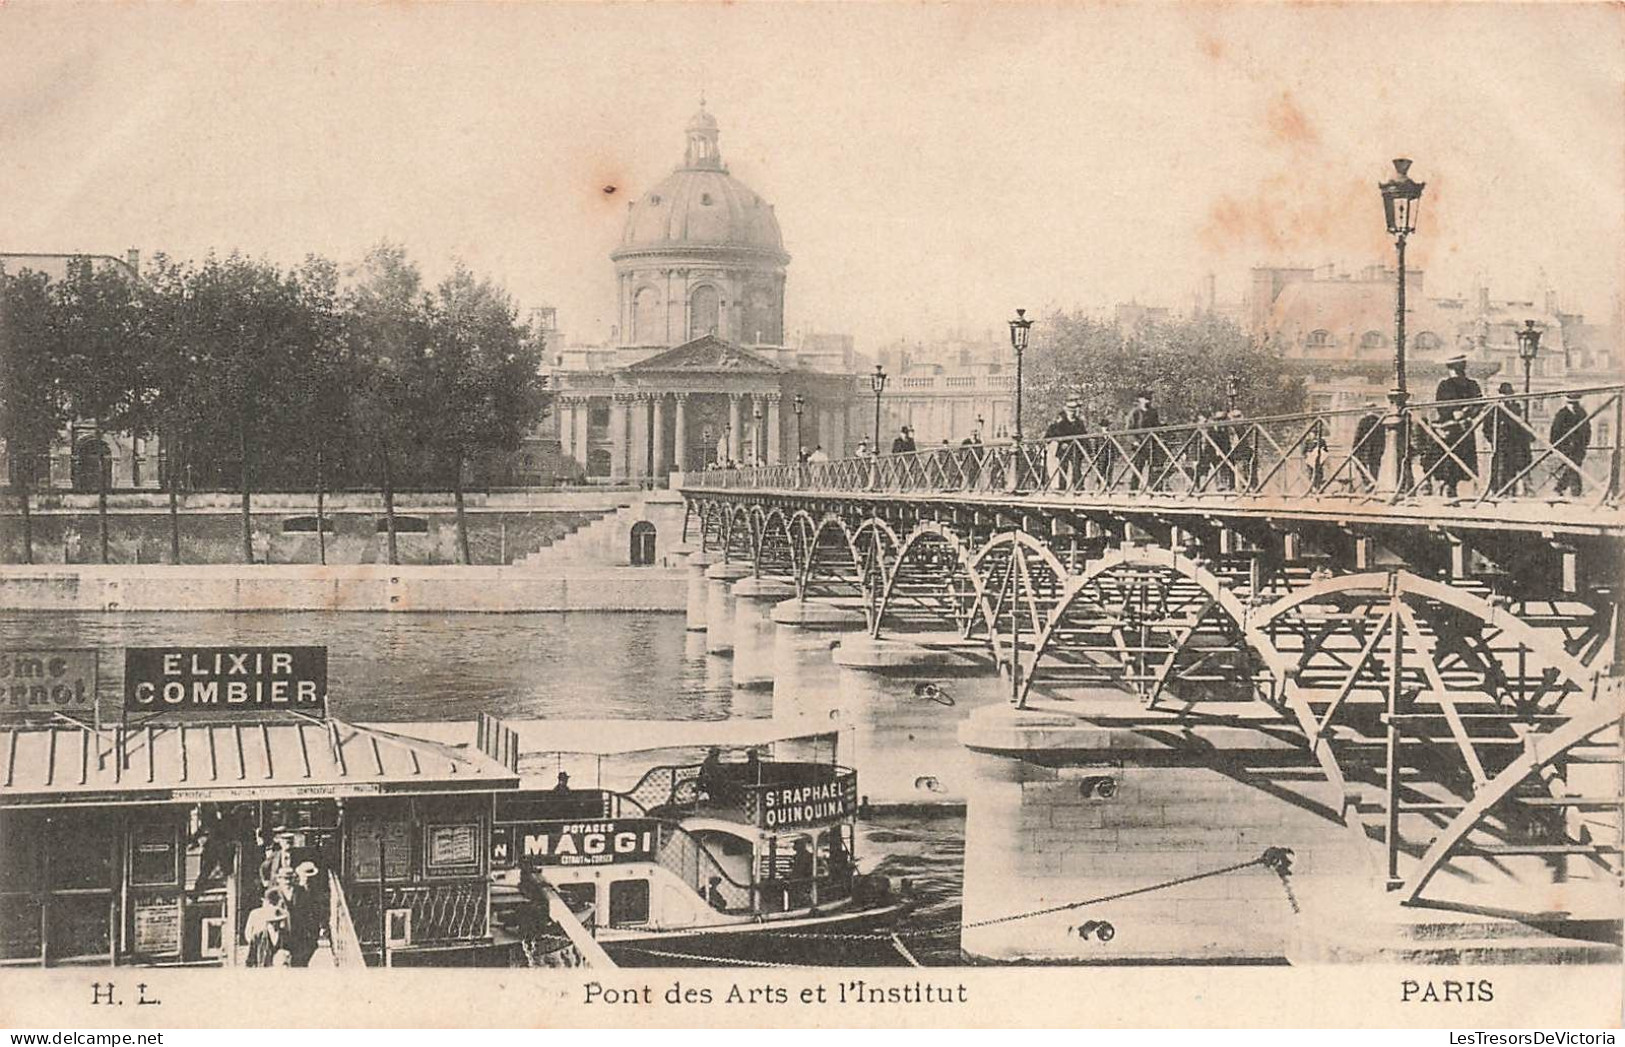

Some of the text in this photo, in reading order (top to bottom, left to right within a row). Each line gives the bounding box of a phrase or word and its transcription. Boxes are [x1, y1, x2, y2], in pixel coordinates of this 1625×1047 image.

[163, 653, 293, 675] ELIXIR
[135, 680, 317, 704] COMBIER
[766, 800, 844, 826] QUINQUINA
[562, 823, 614, 834] POTAGES
[524, 831, 652, 856] MAGGI
[91, 981, 161, 1006] H. L.
[582, 979, 969, 1005] Pont des Arts et l'Institut
[1400, 979, 1495, 1003] PARIS
